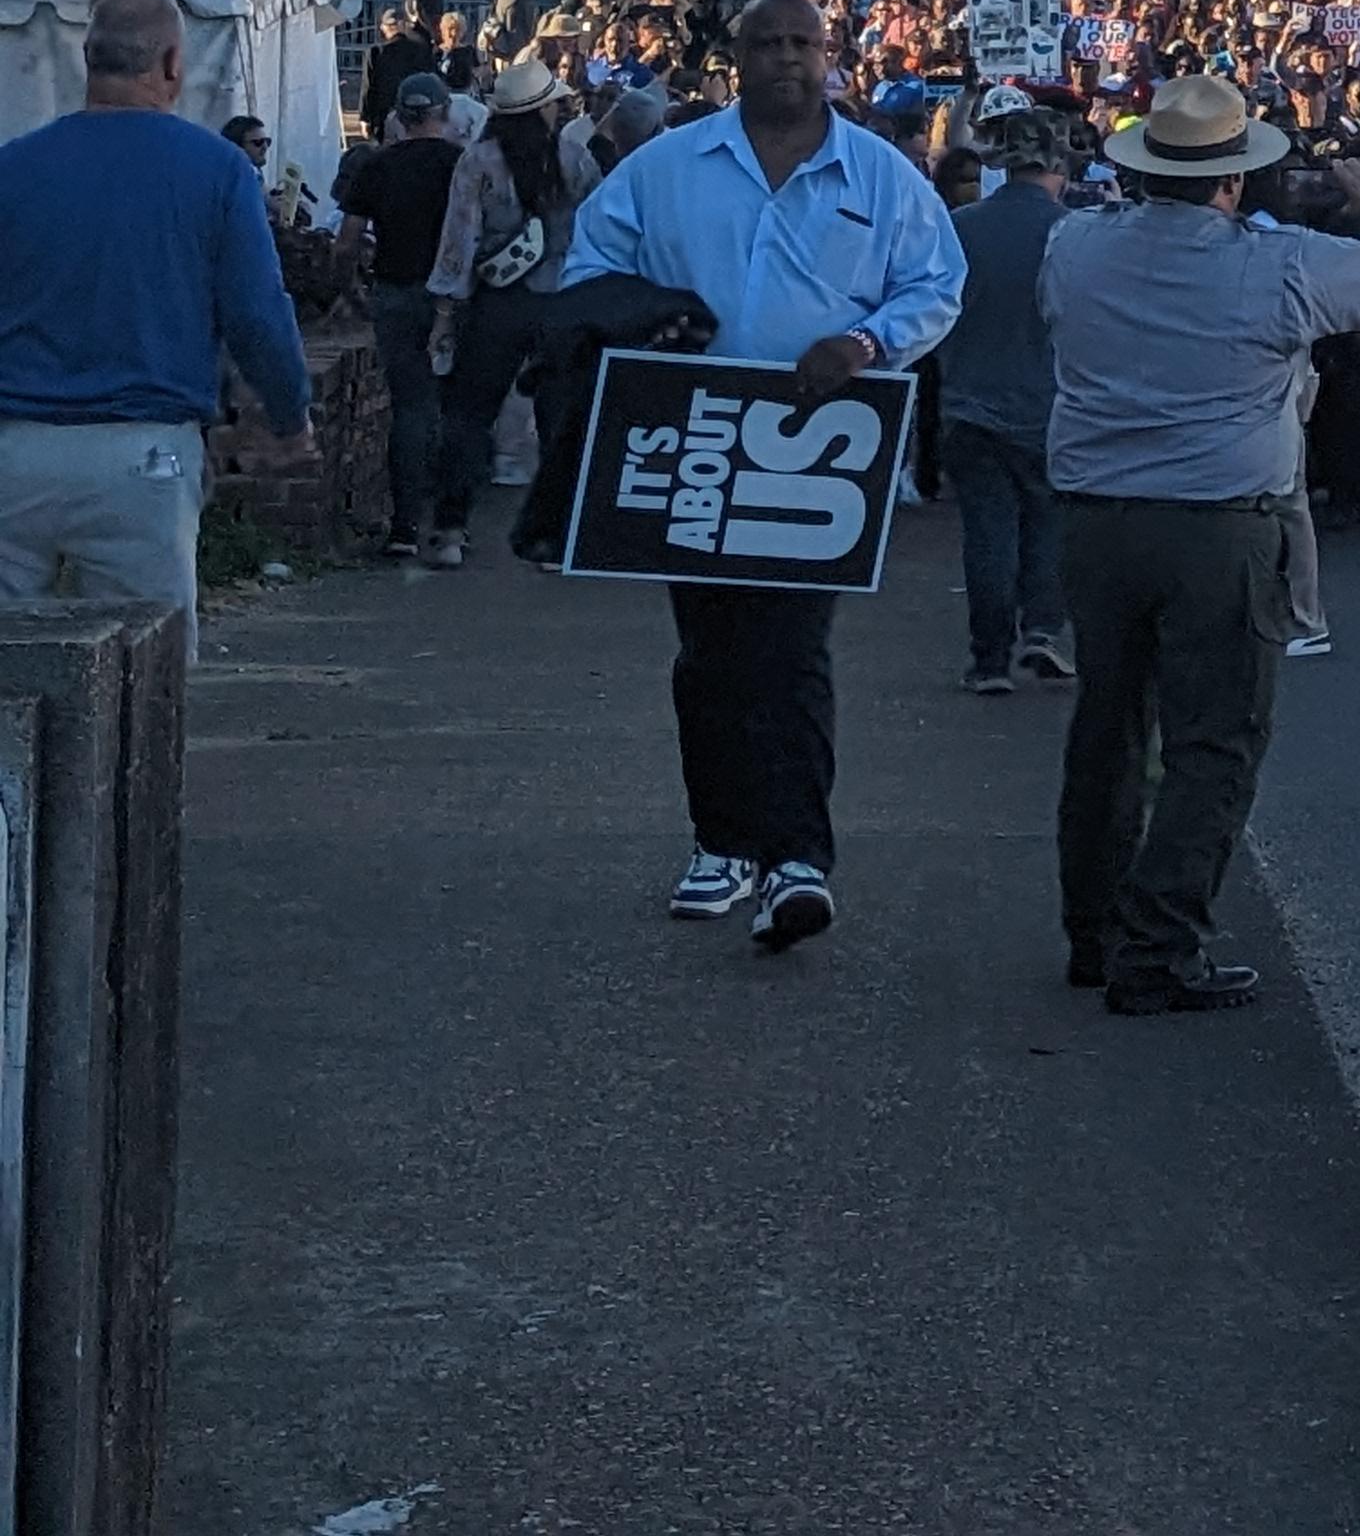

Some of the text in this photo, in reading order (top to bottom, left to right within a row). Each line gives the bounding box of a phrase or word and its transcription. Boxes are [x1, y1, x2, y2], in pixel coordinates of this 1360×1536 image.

[1087, 31, 1128, 44] OUR
[1327, 30, 1358, 44] VOT
[616, 425, 680, 511] IT'S
[665, 388, 743, 554] ABOUT
[721, 398, 883, 561] US
